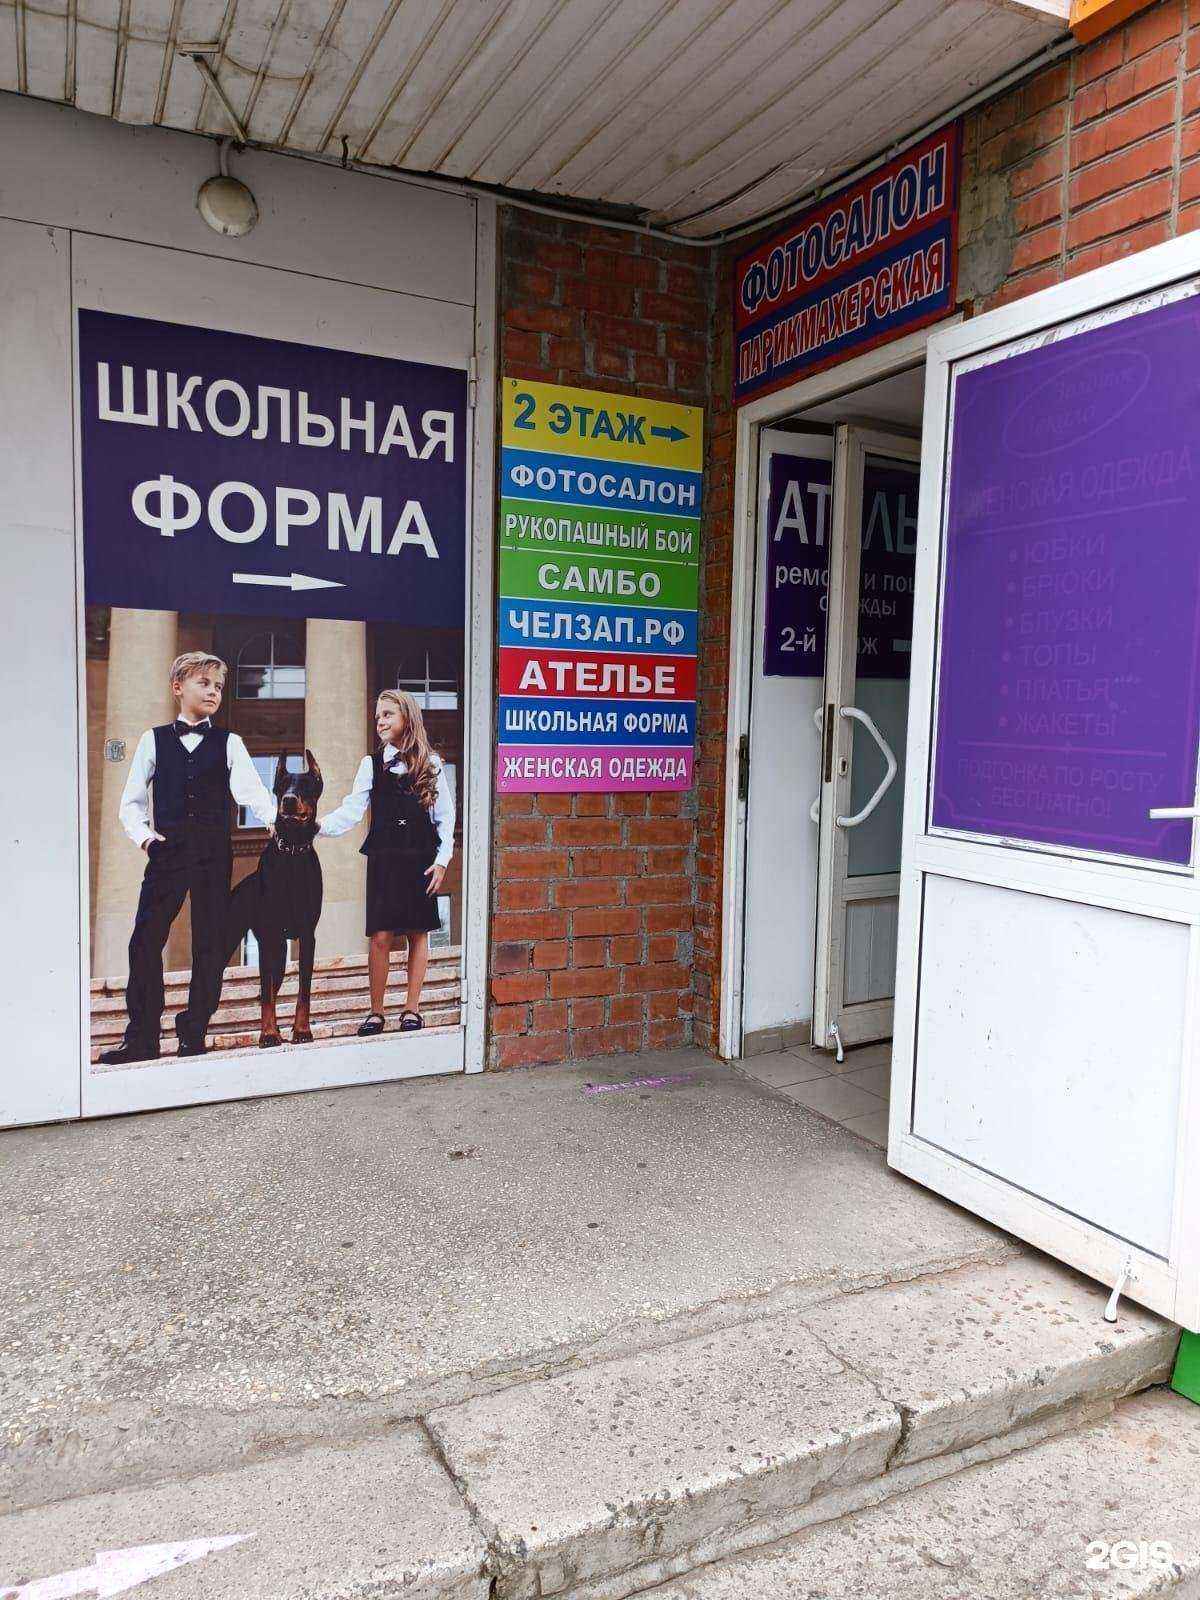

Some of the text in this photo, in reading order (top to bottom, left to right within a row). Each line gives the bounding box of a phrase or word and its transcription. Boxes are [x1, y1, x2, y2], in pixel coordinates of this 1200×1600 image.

[741, 142, 947, 314] ФОТОСАЛОН
[739, 238, 946, 385] ПАРИКМАХЕРСКАЯ
[97, 361, 455, 464] ШКОЛЬНАЯ
[513, 393, 647, 445] 2 ЭТАЖ
[510, 464, 696, 507] ФОТОСАЛОН
[131, 474, 440, 559] ФОРМА
[505, 513, 693, 554] РУКОПАШНЫЙ БОЙ
[538, 563, 662, 598] САМБО
[509, 609, 685, 646] ЧЕЛЗАП.РФ
[1019, 606, 1113, 635] БЛУЗКИ
[780, 626, 816, 652] 2-й
[1020, 642, 1097, 667] ТОПЫ
[518, 660, 676, 695] АТЕЛЬЕ
[1016, 677, 1110, 704] ПЛАТЬЯ
[505, 708, 689, 734] ШКОЛЬНАЯ ФОРМА
[1016, 711, 1117, 737] ЖАКЕТЫ
[503, 756, 687, 782] ЖЕНСКАЯ ОДЕЖДА
[1055, 764, 1084, 788] ПО
[1089, 767, 1166, 793] РОСТУ
